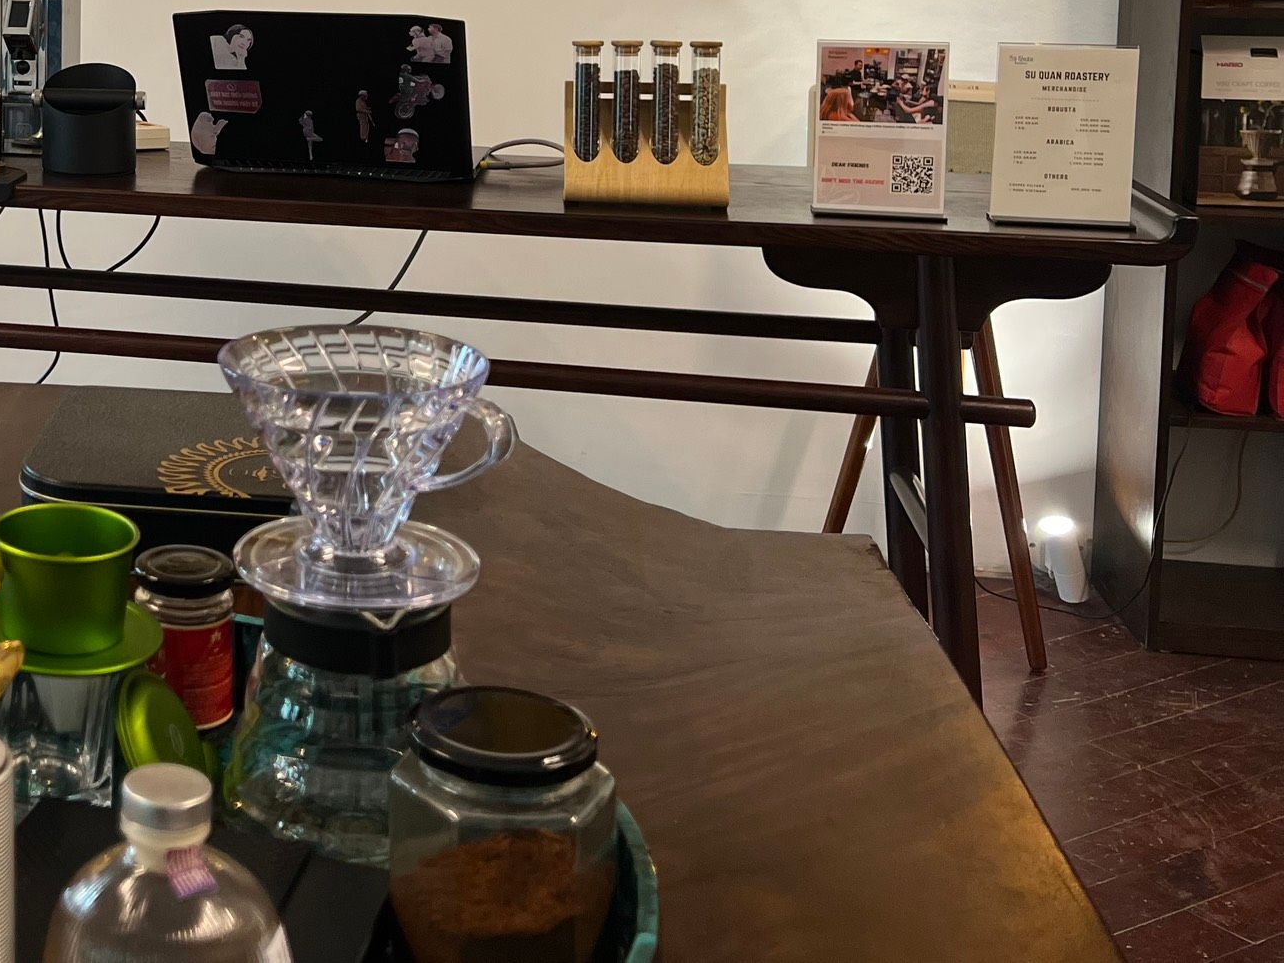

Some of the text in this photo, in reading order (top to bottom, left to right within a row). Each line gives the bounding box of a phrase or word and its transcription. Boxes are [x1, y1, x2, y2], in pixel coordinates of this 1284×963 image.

[1025, 70, 1110, 81] SU QUAN ROASTERY
[1042, 85, 1087, 93] MERCHANDISE
